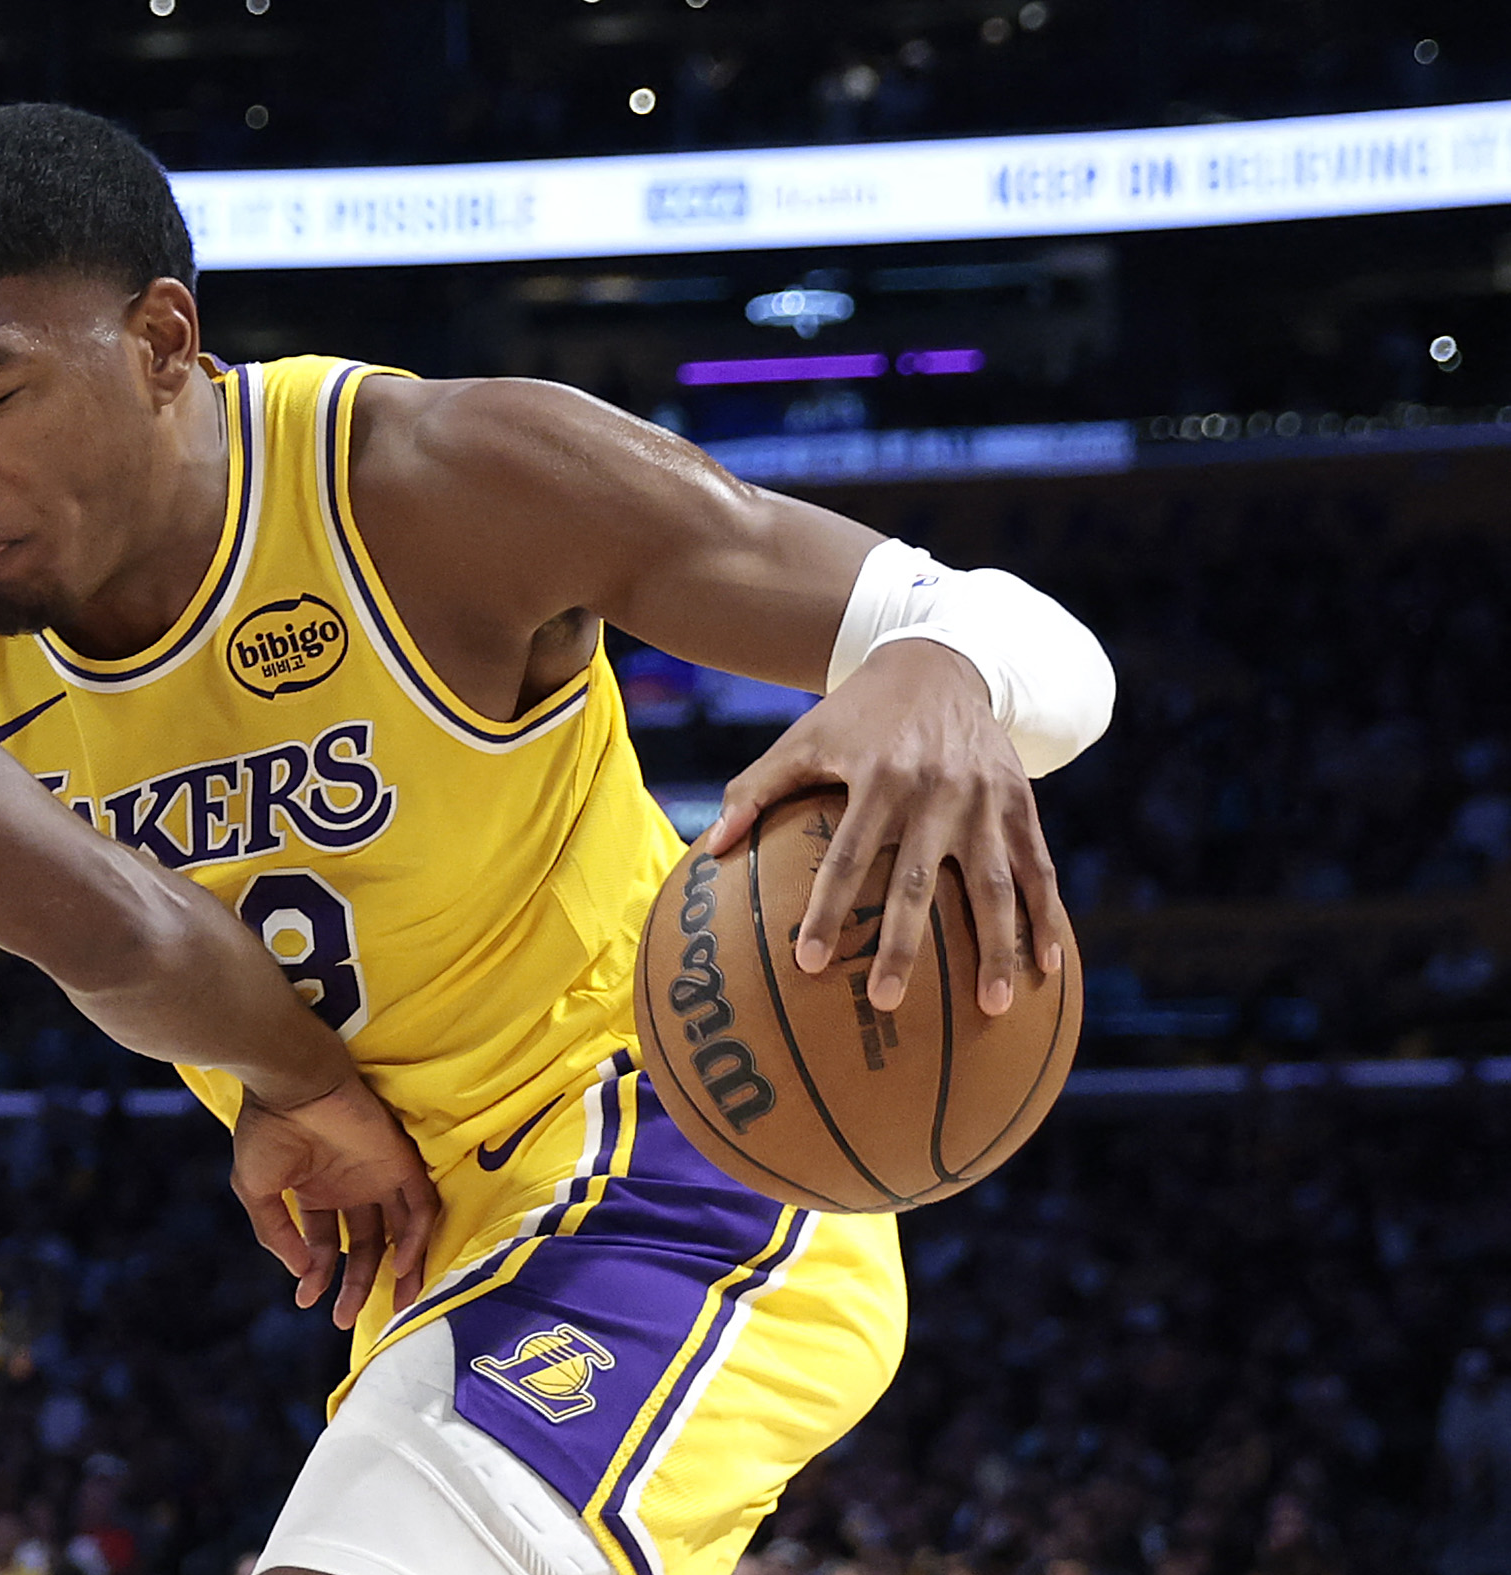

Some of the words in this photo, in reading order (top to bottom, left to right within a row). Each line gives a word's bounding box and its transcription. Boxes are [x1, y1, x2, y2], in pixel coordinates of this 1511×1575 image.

[235, 620, 340, 669] bibigo
[261, 654, 306, 678] 비비고
[34, 719, 398, 871] KERS
[668, 852, 777, 1136] Wilson
